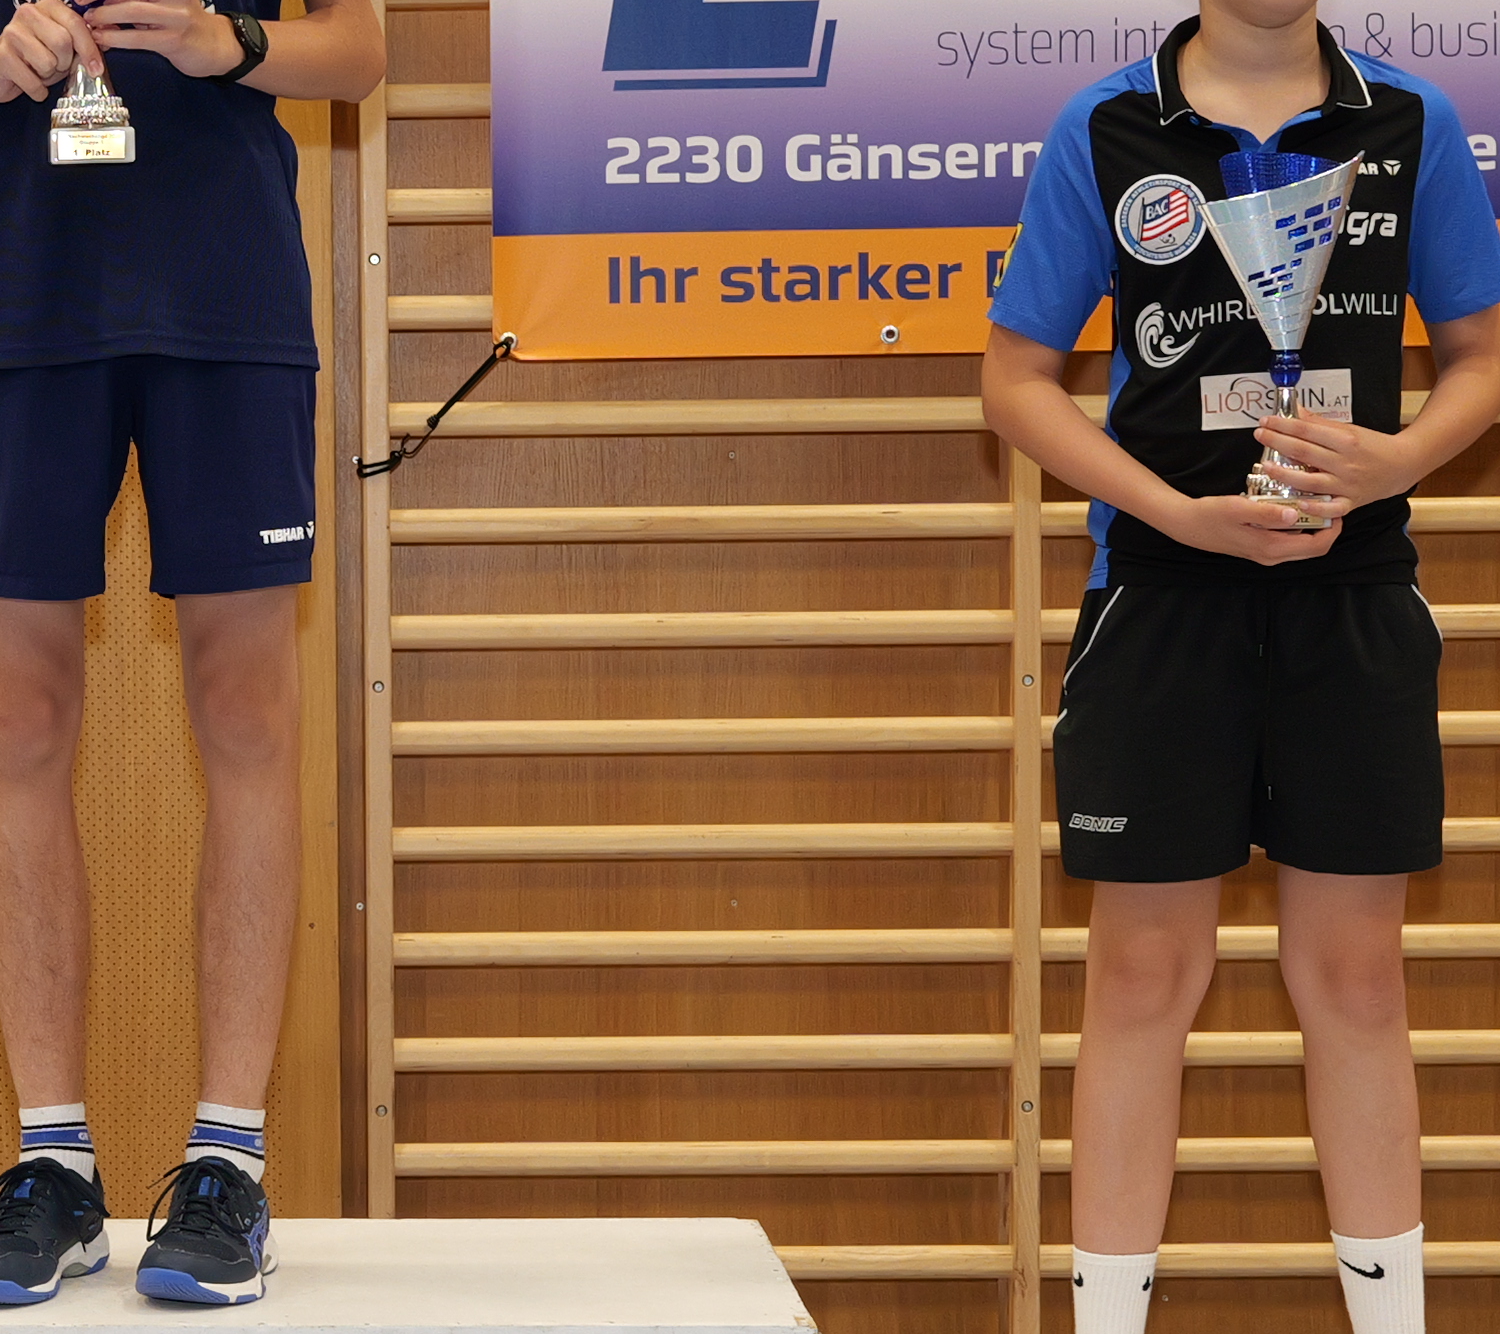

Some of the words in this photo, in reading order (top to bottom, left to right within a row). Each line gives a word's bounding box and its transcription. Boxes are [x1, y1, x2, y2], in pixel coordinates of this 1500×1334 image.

[936, 20, 1095, 79] system
[1365, 12, 1393, 59] &
[604, 134, 764, 185] 2230
[785, 133, 1045, 183] Gänsern
[1146, 198, 1169, 221] BAC
[607, 254, 699, 305] Ihr
[719, 251, 963, 304] starker
[259, 526, 305, 545] TIBHAR
